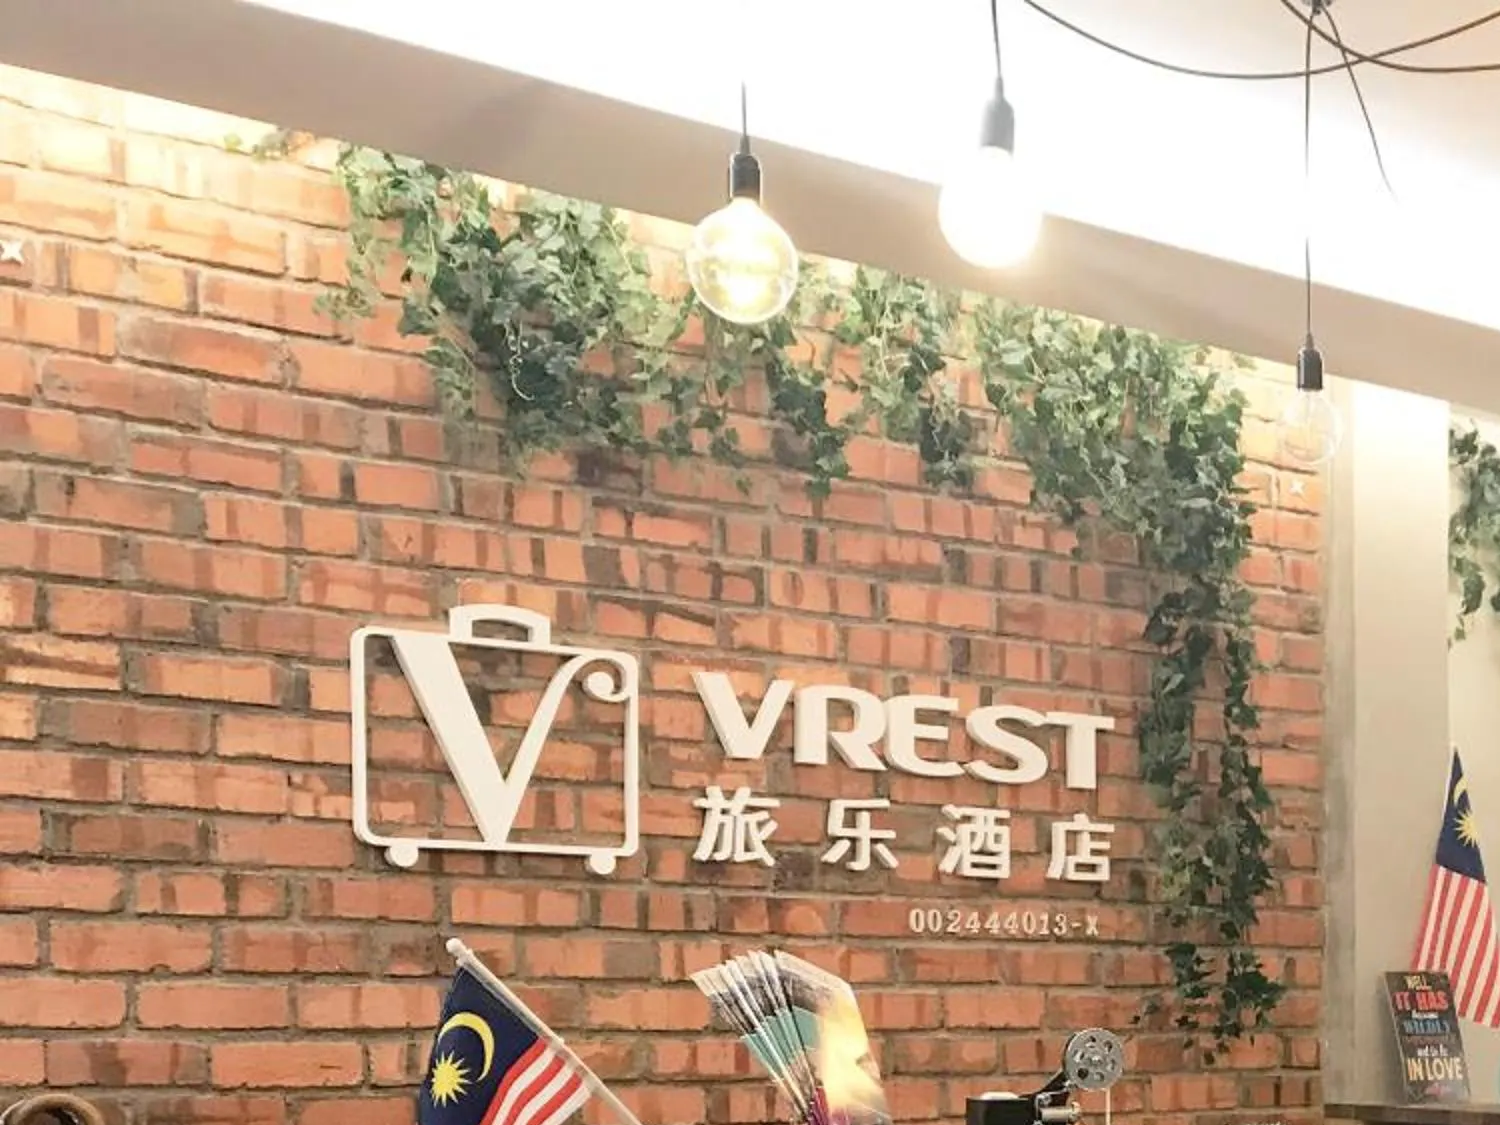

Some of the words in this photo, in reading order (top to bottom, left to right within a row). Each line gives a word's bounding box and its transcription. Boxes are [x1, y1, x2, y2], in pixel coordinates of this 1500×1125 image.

[690, 671, 1116, 789] VREST
[692, 785, 1116, 882] 旅乐酒店
[1425, 1057, 1464, 1080] LOVE
